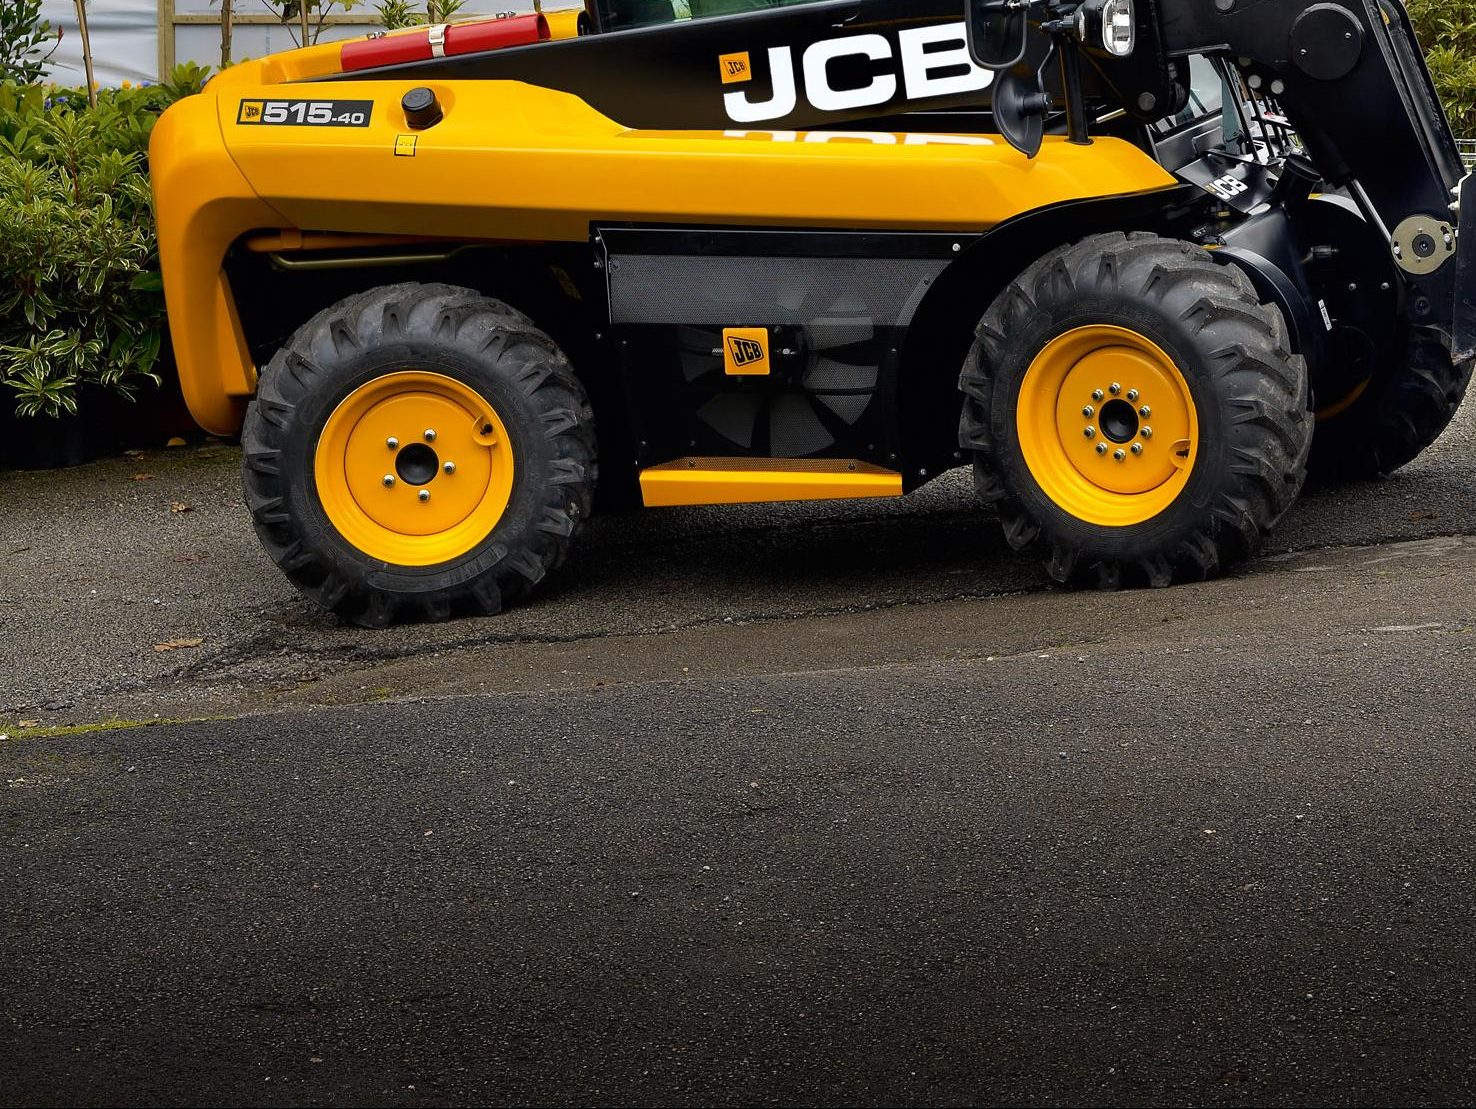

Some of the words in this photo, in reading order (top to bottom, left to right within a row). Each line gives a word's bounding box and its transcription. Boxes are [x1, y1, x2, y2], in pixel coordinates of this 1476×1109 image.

[722, 21, 995, 123] JCB
[727, 60, 746, 75] JCB
[246, 106, 260, 117] JCB
[1209, 174, 1249, 200] JCB
[733, 339, 762, 364] JCB
